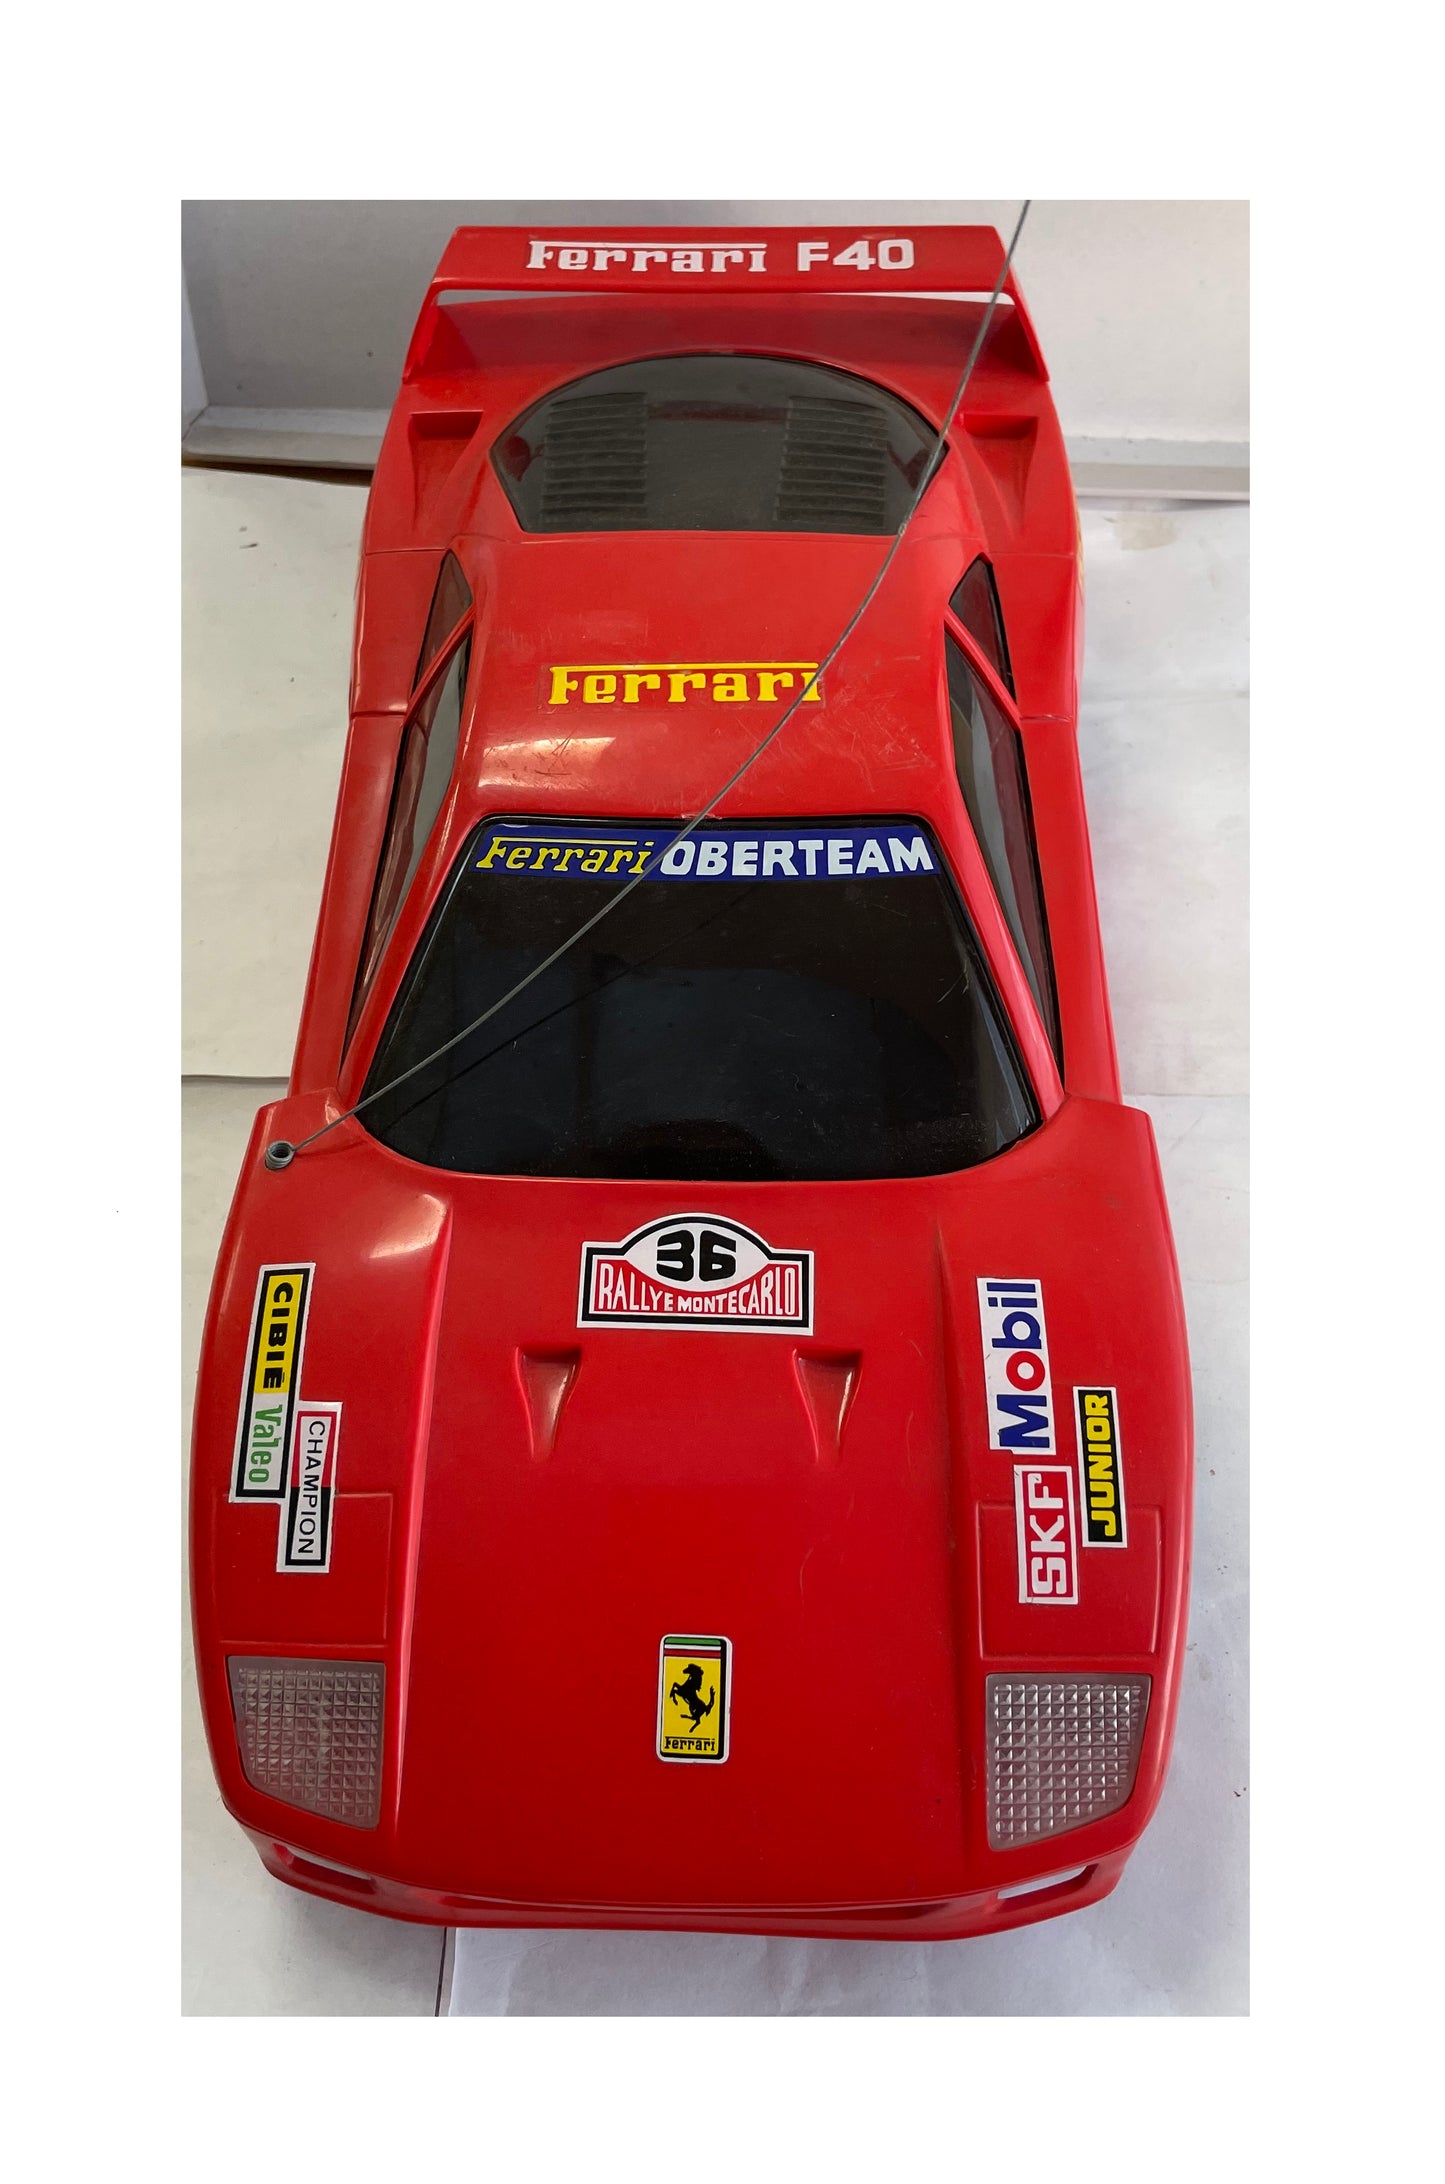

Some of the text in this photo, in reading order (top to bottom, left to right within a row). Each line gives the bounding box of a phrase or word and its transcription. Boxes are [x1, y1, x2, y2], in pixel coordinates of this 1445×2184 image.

[526, 238, 914, 272] Ferrari F40
[548, 662, 822, 705] Ferrari
[475, 836, 934, 876] Ferrari OBERTEAM
[656, 1229, 736, 1282] 36
[986, 1282, 1050, 1448] Mobil
[248, 1404, 283, 1483] Valeo
[1084, 1393, 1117, 1537] JUNIOR
[297, 1420, 326, 1555] CHAMPION
[1027, 1472, 1068, 1596] SKF
[664, 1736, 716, 1752] Ferrari
